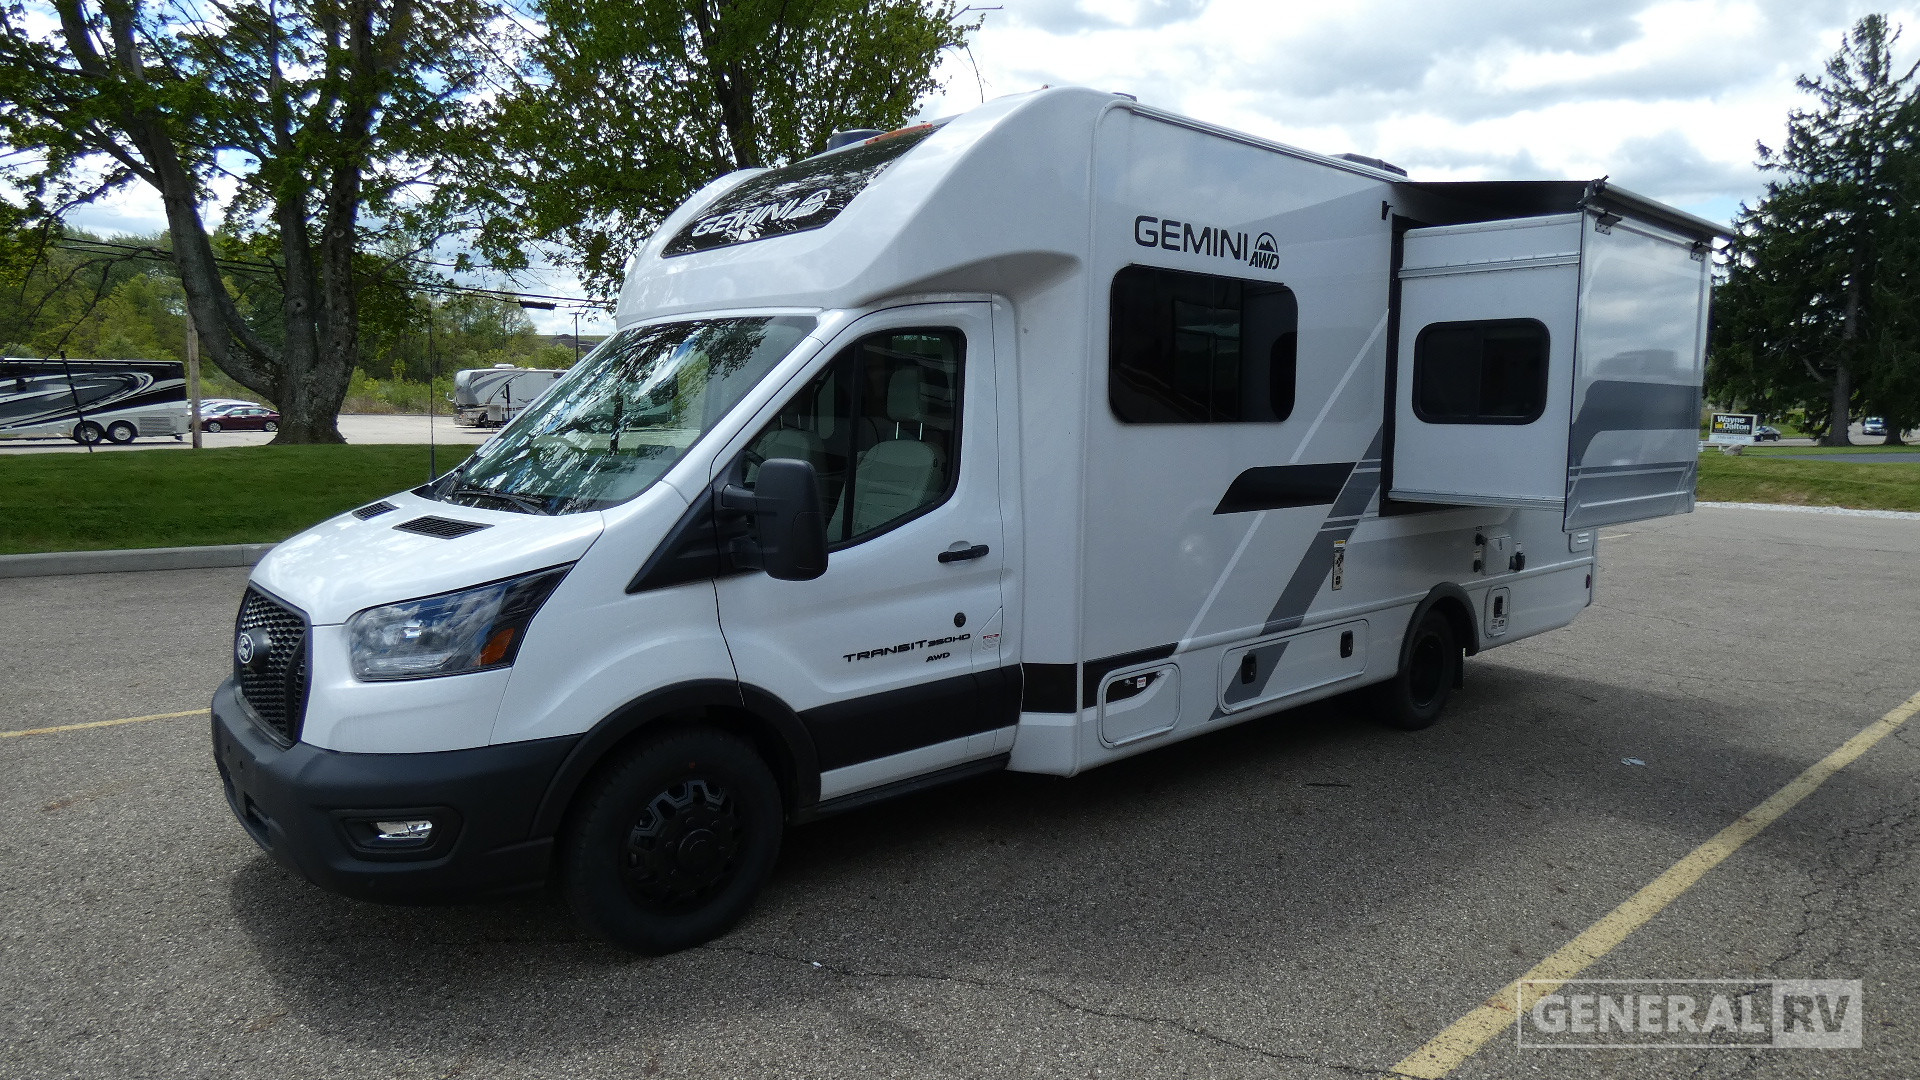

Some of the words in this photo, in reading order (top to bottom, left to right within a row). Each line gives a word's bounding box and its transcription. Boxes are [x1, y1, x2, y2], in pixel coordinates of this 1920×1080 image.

[692, 198, 800, 237] GEMINI
[1134, 215, 1248, 261] GEMINI
[1249, 251, 1280, 270] AWD
[1717, 416, 1745, 424] Wayne
[843, 640, 928, 662] TRANSIT
[925, 652, 951, 662] AWD
